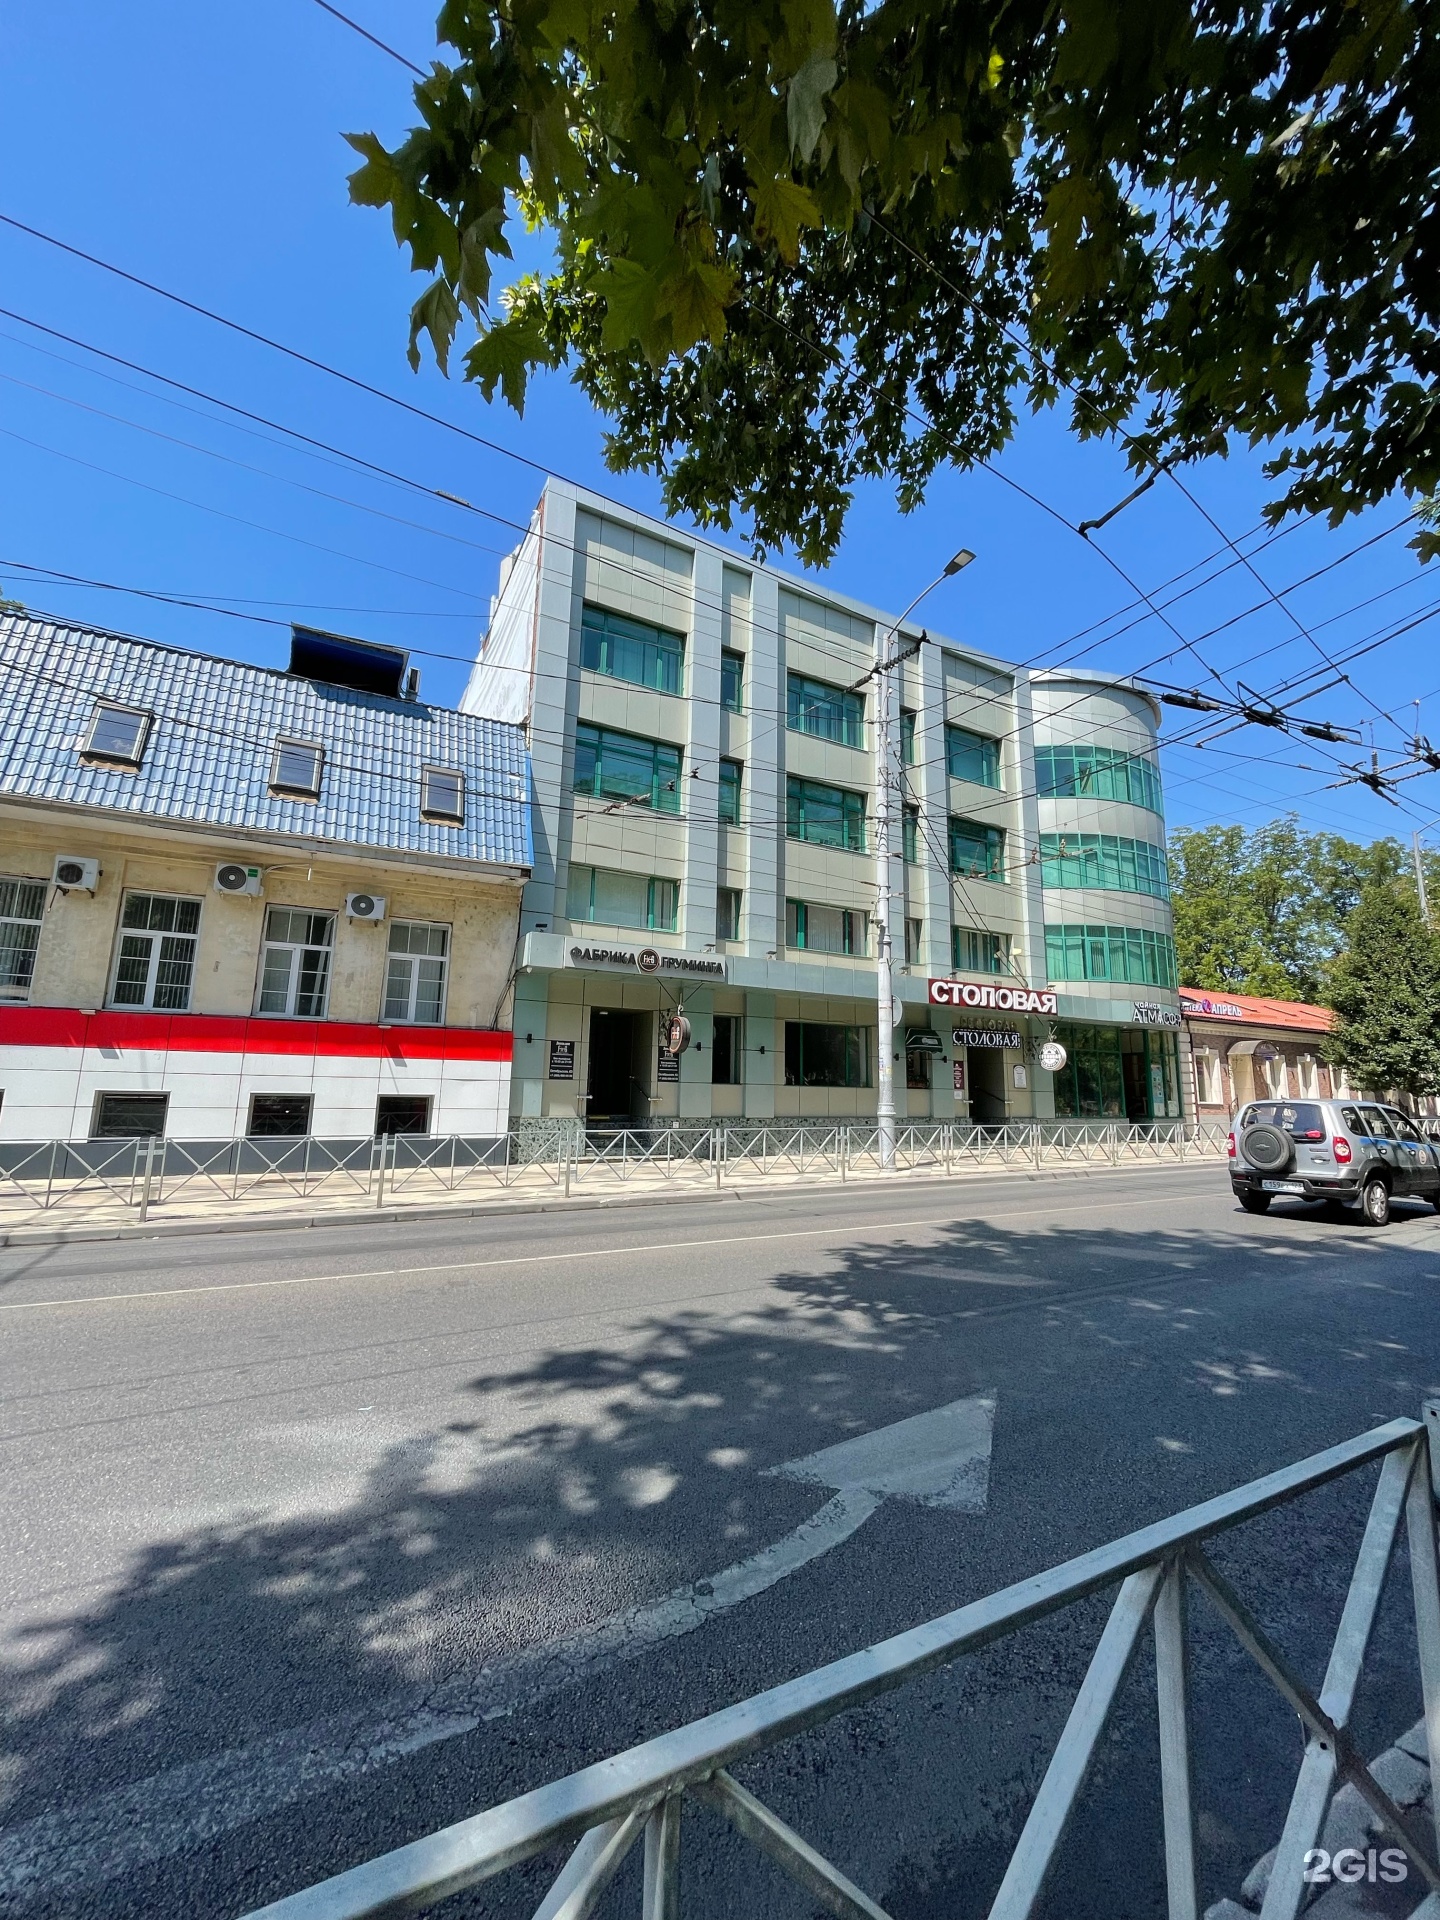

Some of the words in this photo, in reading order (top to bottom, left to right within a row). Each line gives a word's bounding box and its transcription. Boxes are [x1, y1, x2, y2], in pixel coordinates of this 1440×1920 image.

[570, 946, 636, 965] ФАБРИКА
[660, 956, 724, 975] ГРУМИНГА
[931, 981, 1057, 1013] СТОЛОВАЯ
[1211, 1004, 1242, 1017] АПРЕЛЬ
[953, 1031, 1019, 1047] СТОЛОВАЯ
